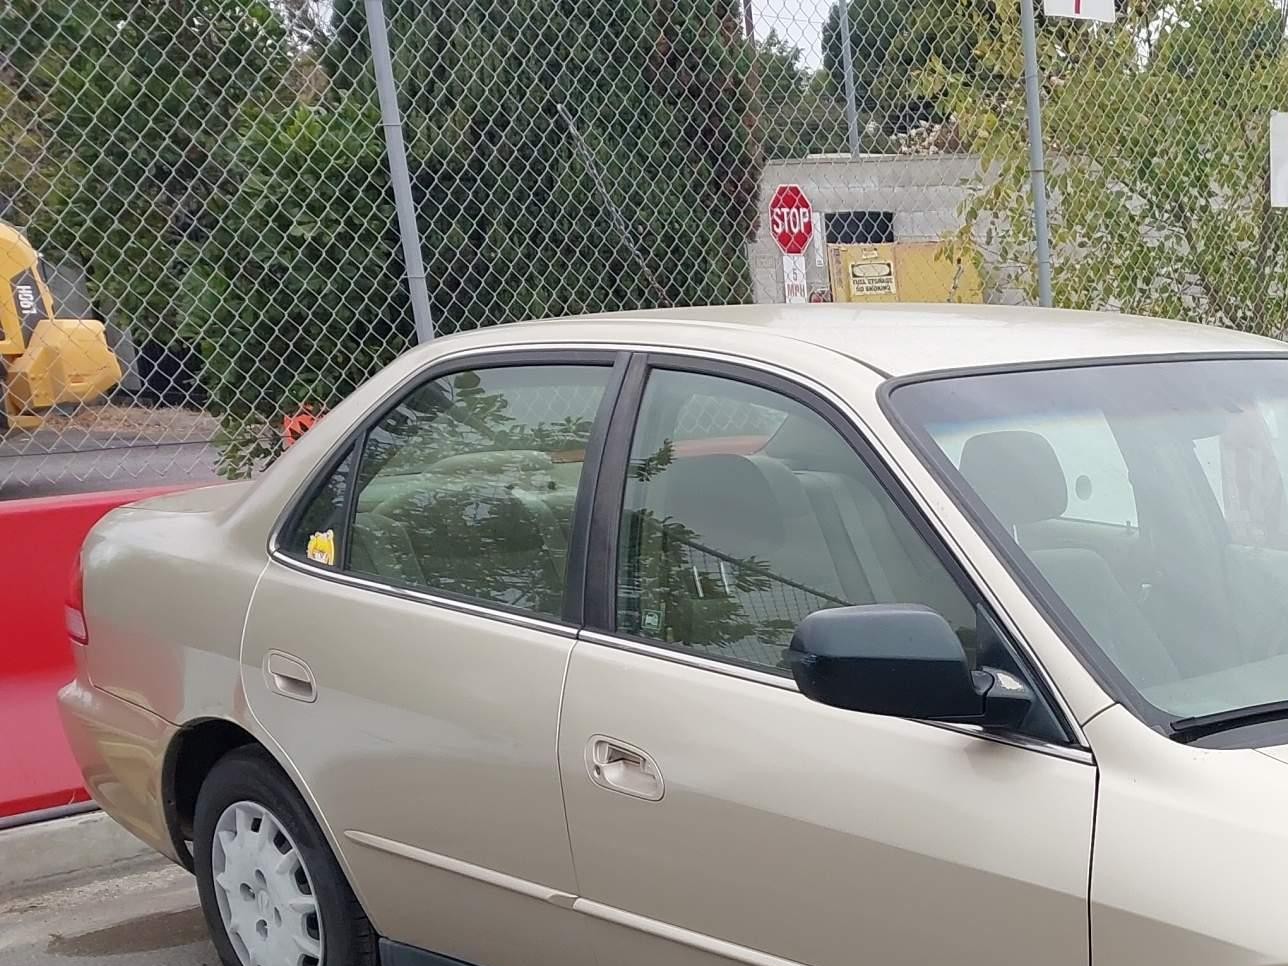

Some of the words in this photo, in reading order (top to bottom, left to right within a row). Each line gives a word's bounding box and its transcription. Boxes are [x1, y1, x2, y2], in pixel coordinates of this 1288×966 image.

[773, 207, 809, 234] STOP
[792, 268, 798, 281] 5
[16, 285, 37, 314] L90H
[786, 283, 805, 297] MPH
